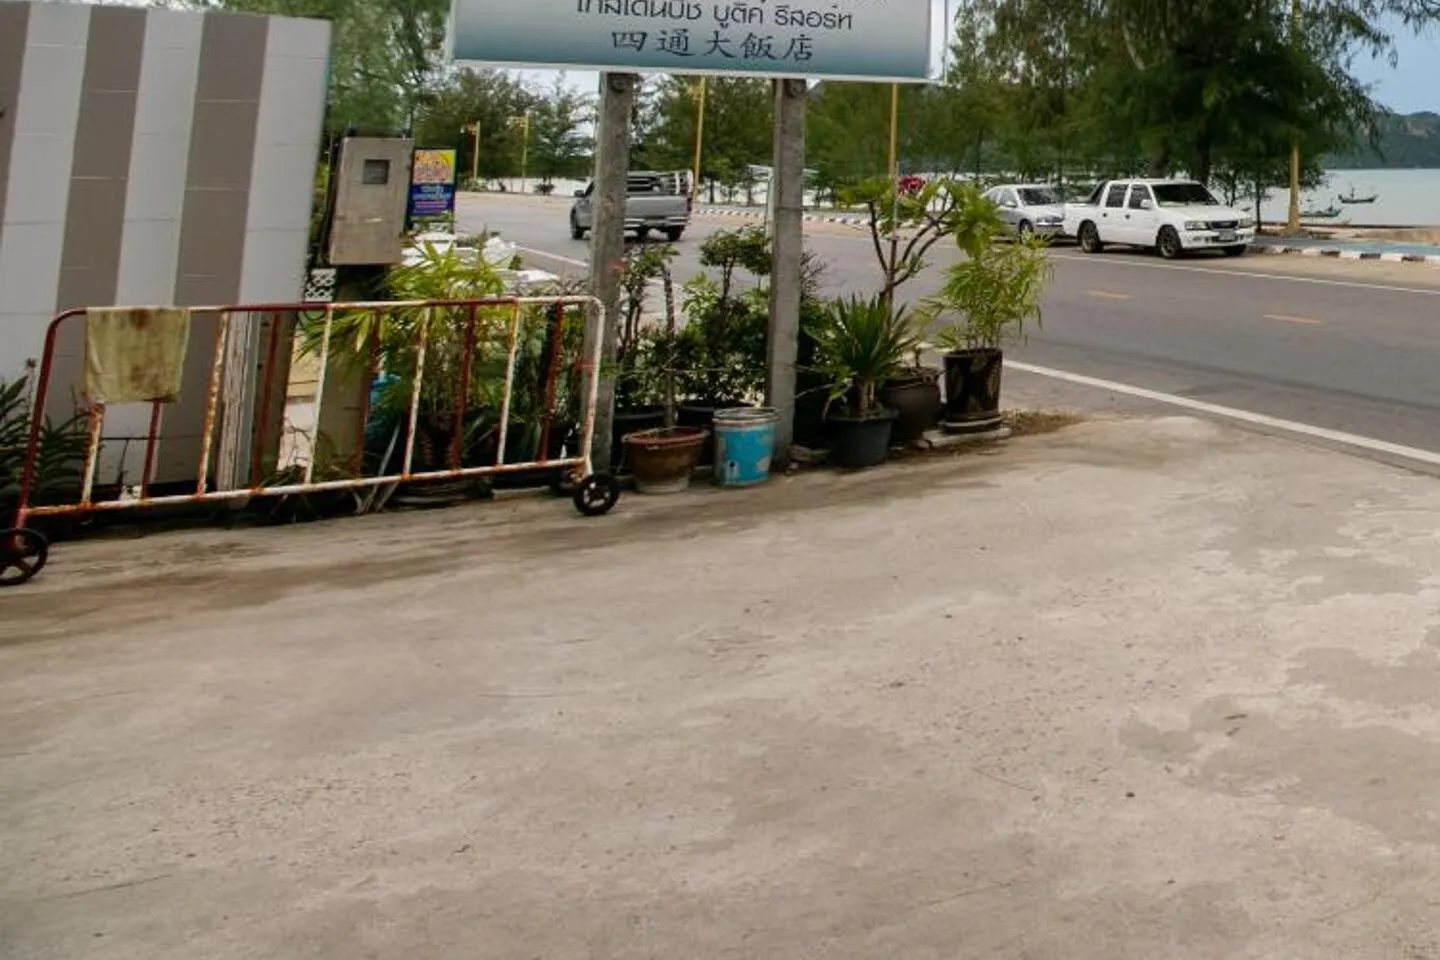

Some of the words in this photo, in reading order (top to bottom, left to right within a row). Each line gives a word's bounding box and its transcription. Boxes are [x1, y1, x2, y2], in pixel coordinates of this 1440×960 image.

[611, 28, 815, 62] 四通大飯店
